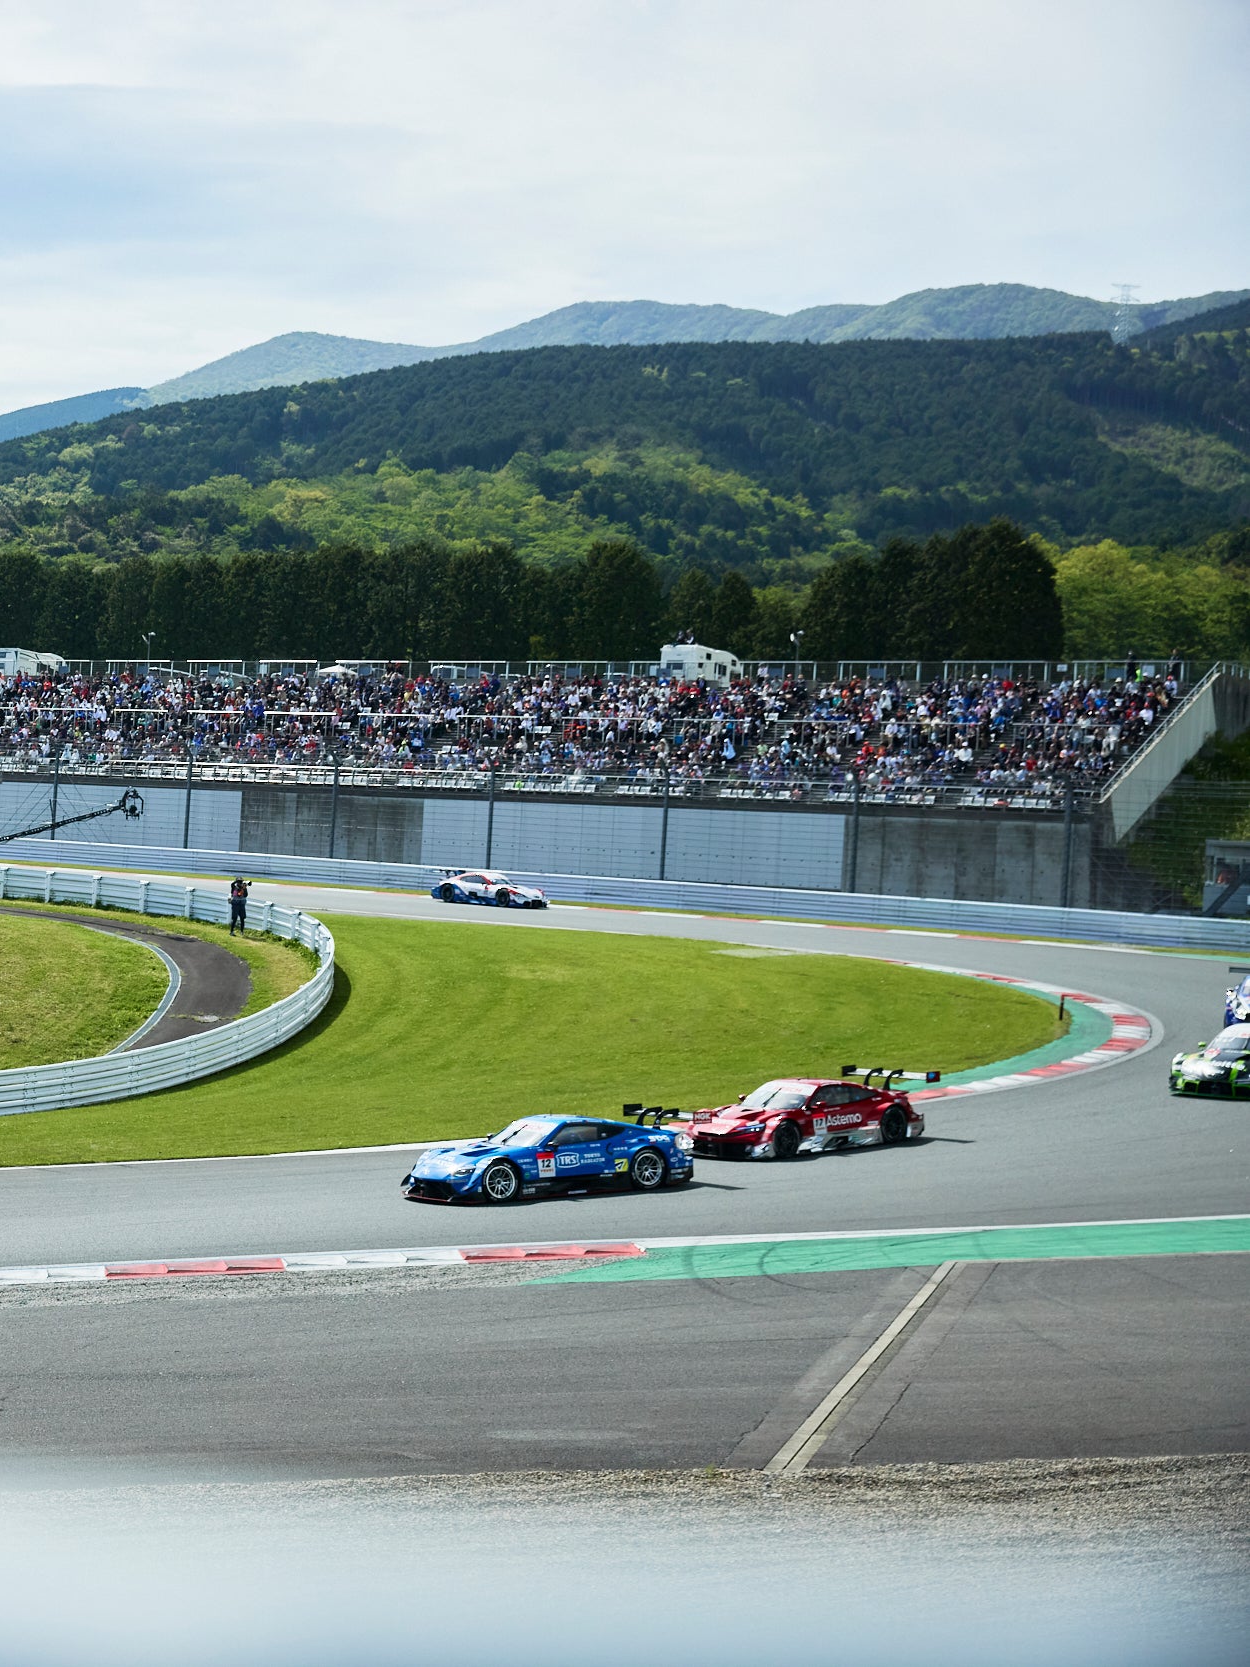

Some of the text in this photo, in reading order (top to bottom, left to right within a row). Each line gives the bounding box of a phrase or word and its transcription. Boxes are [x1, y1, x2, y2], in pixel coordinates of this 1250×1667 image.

[826, 1113, 863, 1126] Astemo
[541, 1159, 552, 1168] 12
[559, 1155, 578, 1165] TRS
